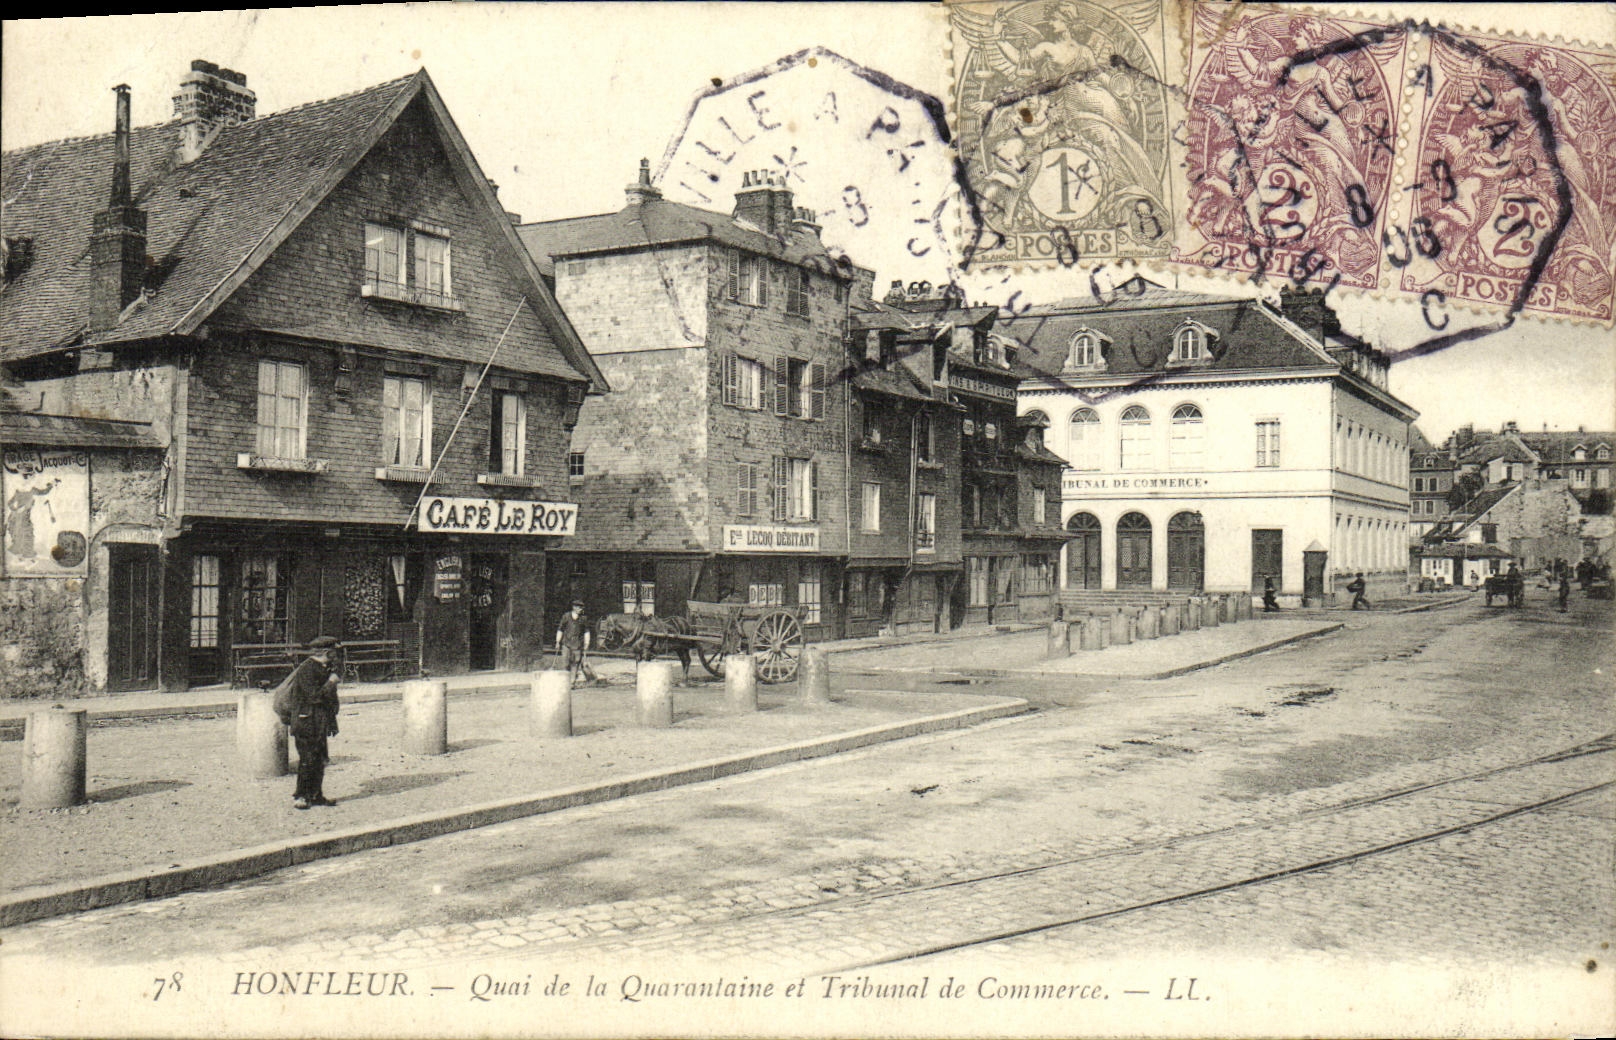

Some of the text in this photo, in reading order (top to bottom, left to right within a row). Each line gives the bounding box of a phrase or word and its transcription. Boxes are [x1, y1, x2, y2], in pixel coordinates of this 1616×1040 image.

[1020, 231, 1113, 258] POSTES
[1227, 246, 1319, 278] POSTES
[1462, 275, 1552, 308] POSTES
[1062, 478, 1203, 490] IBUNAL DE COMMERCE
[426, 498, 575, 533] CAFÉ LE ROY
[746, 529, 774, 548] LECOQ
